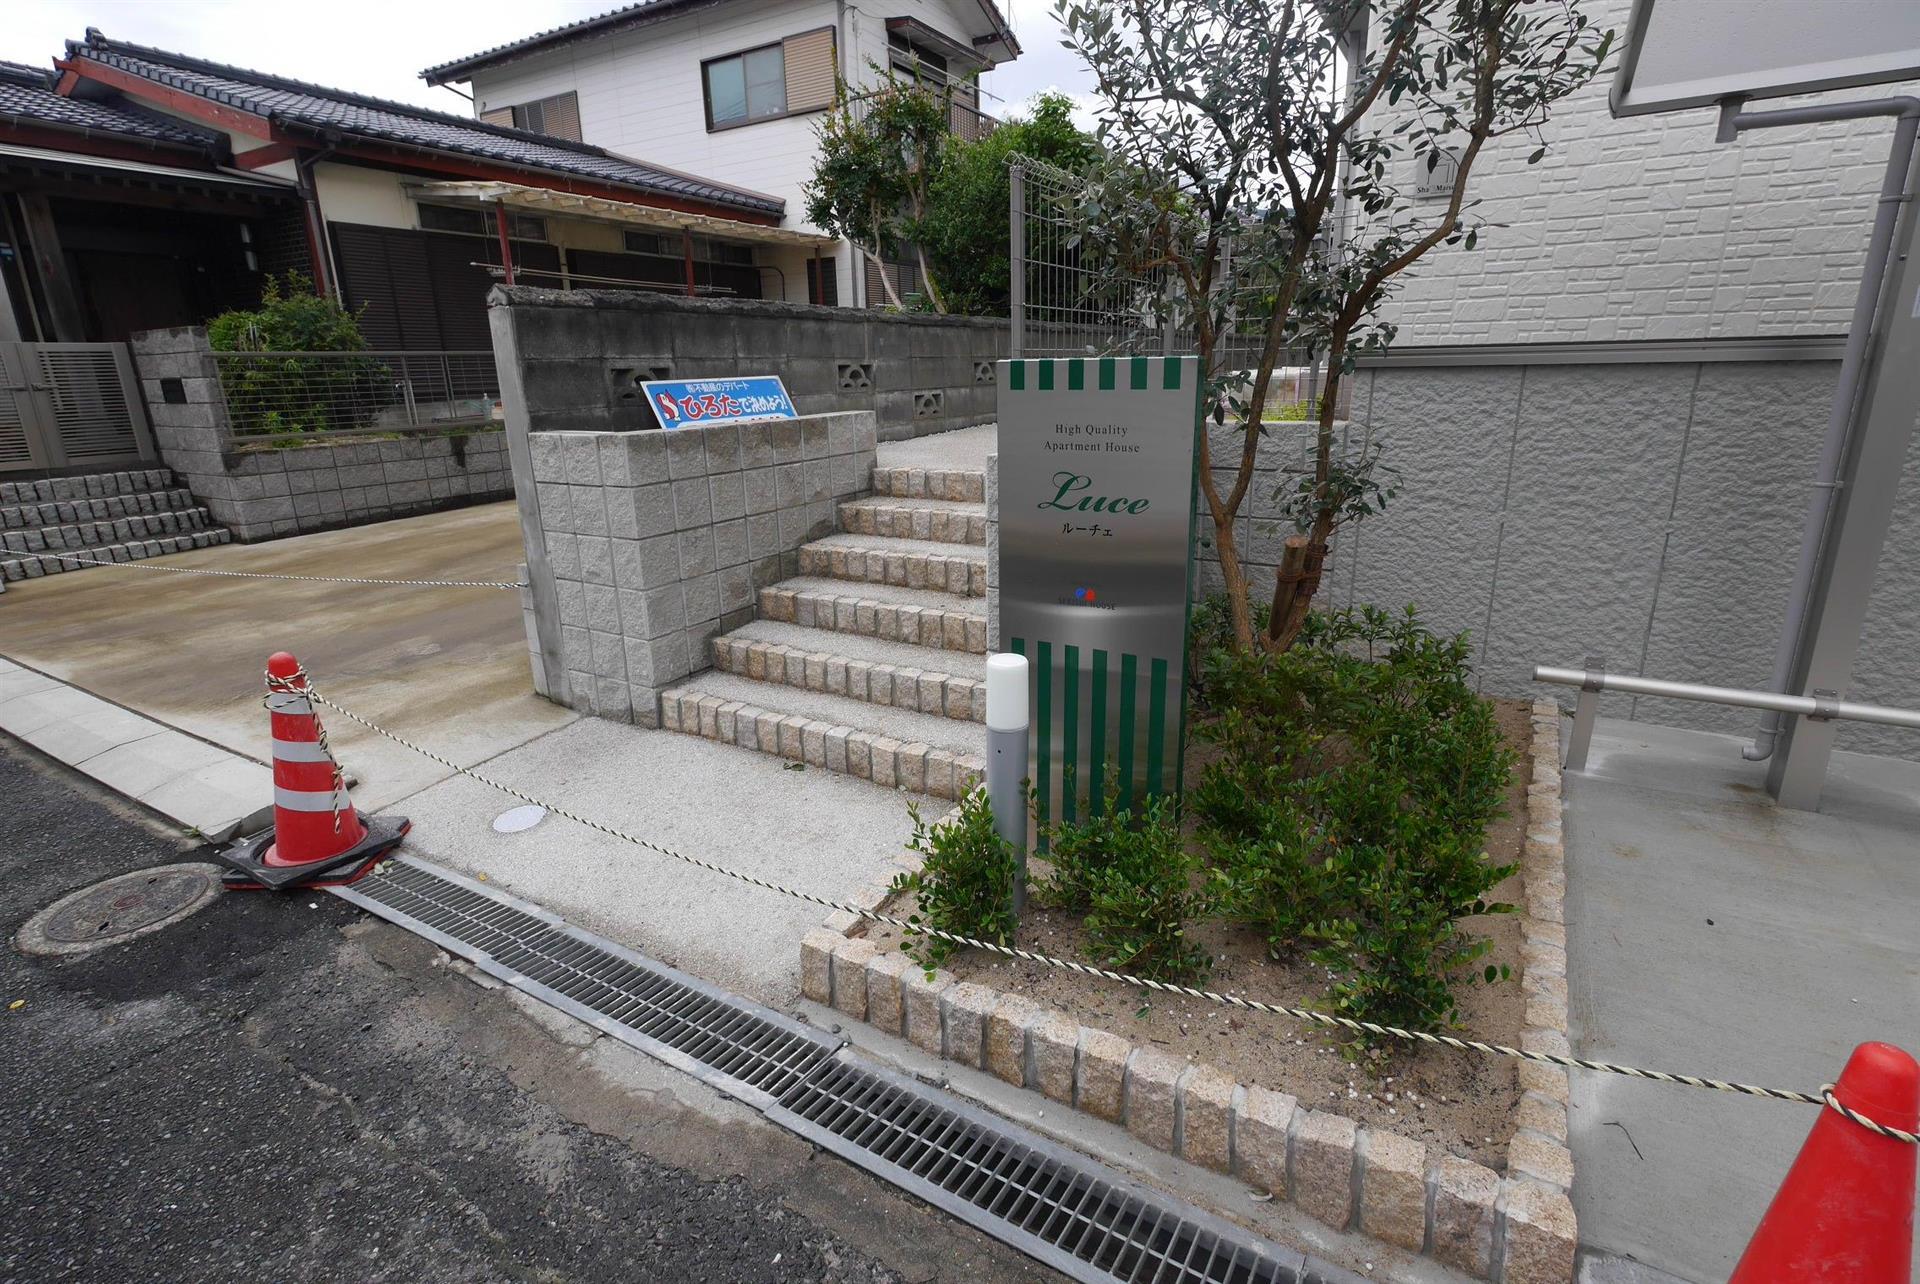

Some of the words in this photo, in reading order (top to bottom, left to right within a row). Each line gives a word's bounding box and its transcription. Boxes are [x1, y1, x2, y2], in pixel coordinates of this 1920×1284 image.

[1055, 424, 1081, 436] High
[1085, 424, 1128, 438] Quality
[1044, 441, 1101, 453] Apartment
[1105, 442, 1141, 453] House
[1037, 471, 1151, 515] Luce
[1061, 522, 1113, 537] ルーチェ
